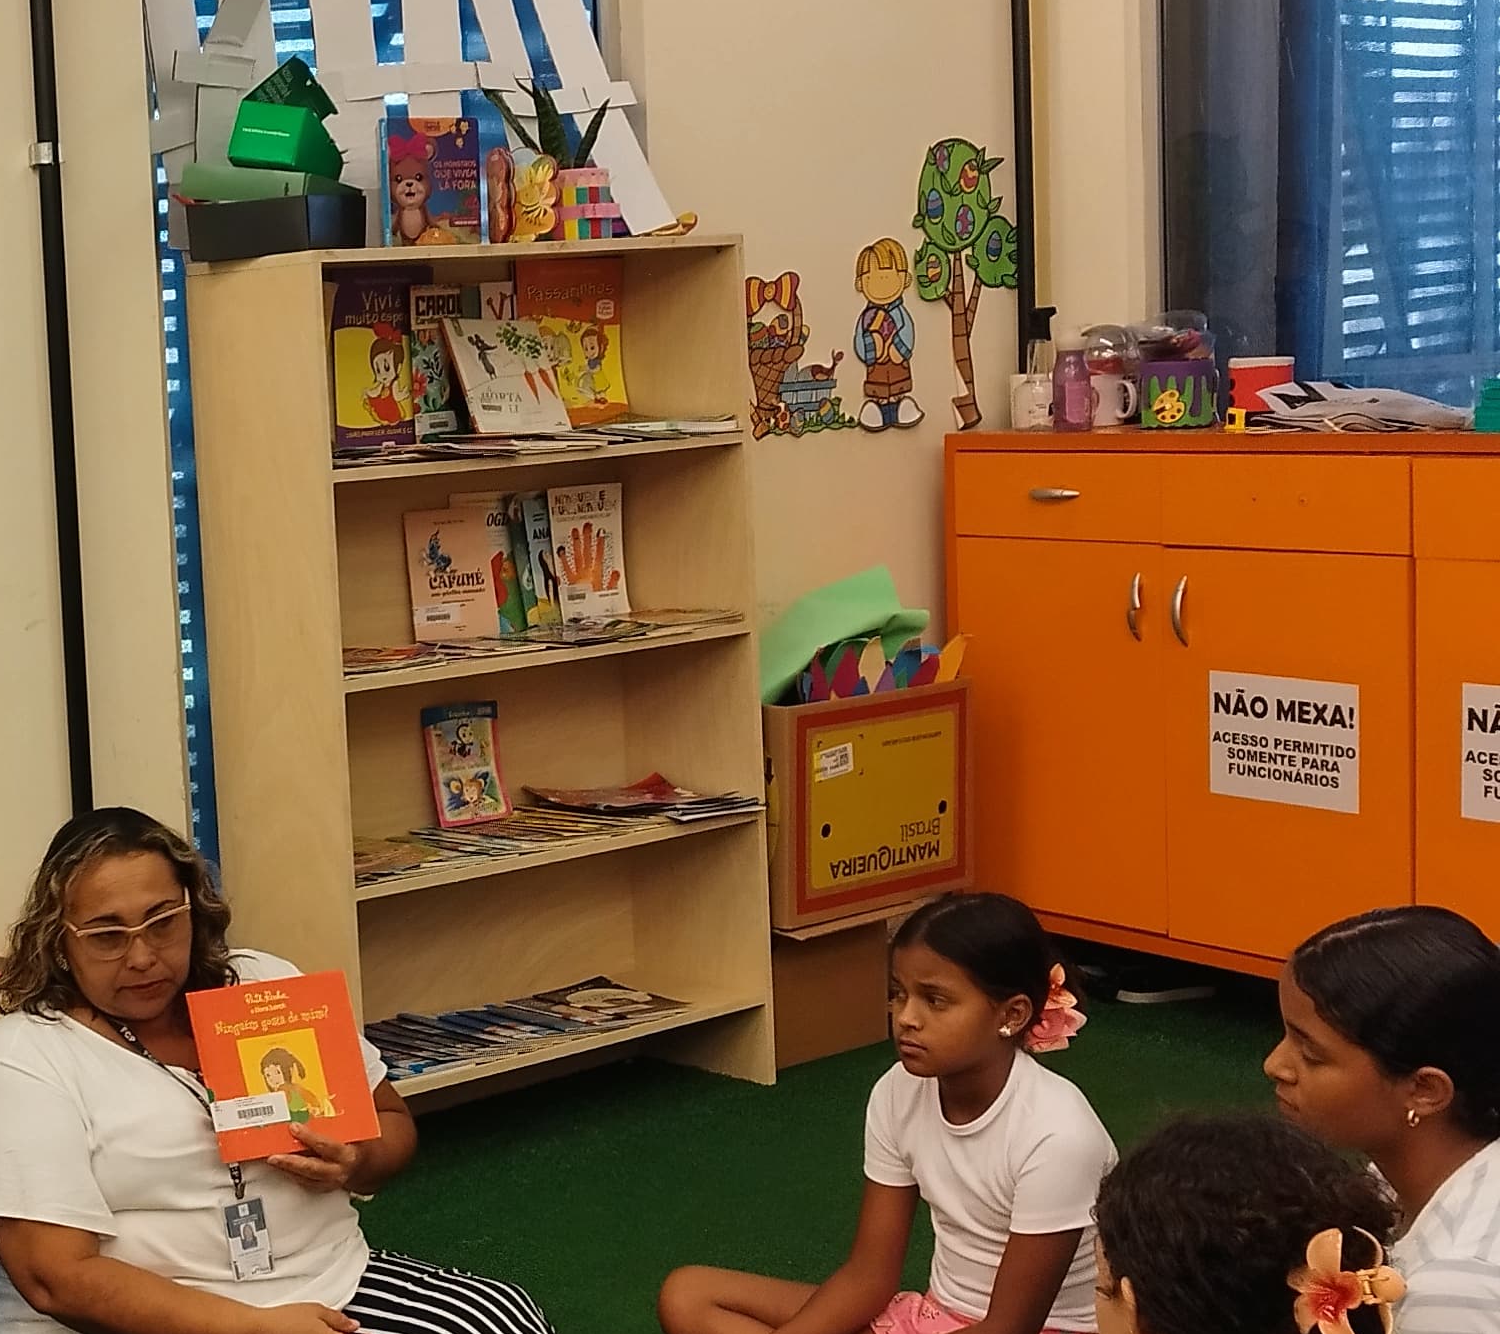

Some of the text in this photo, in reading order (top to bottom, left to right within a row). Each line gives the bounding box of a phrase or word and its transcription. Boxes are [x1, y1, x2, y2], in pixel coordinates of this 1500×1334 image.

[435, 169, 477, 178] QUE VIVEM
[452, 180, 477, 189] FORA
[345, 312, 379, 326] muito
[1213, 688, 1356, 730] NÃO MEXA!
[1212, 730, 1357, 760] ACESSO PERMITIDO
[1465, 750, 1500, 766] ACE
[1227, 746, 1341, 774] SOMENTE PARA
[1228, 763, 1340, 790] FUNCIONÁRIOS
[900, 817, 941, 842] Brasil
[829, 839, 940, 879] MANTIQUEIRA
